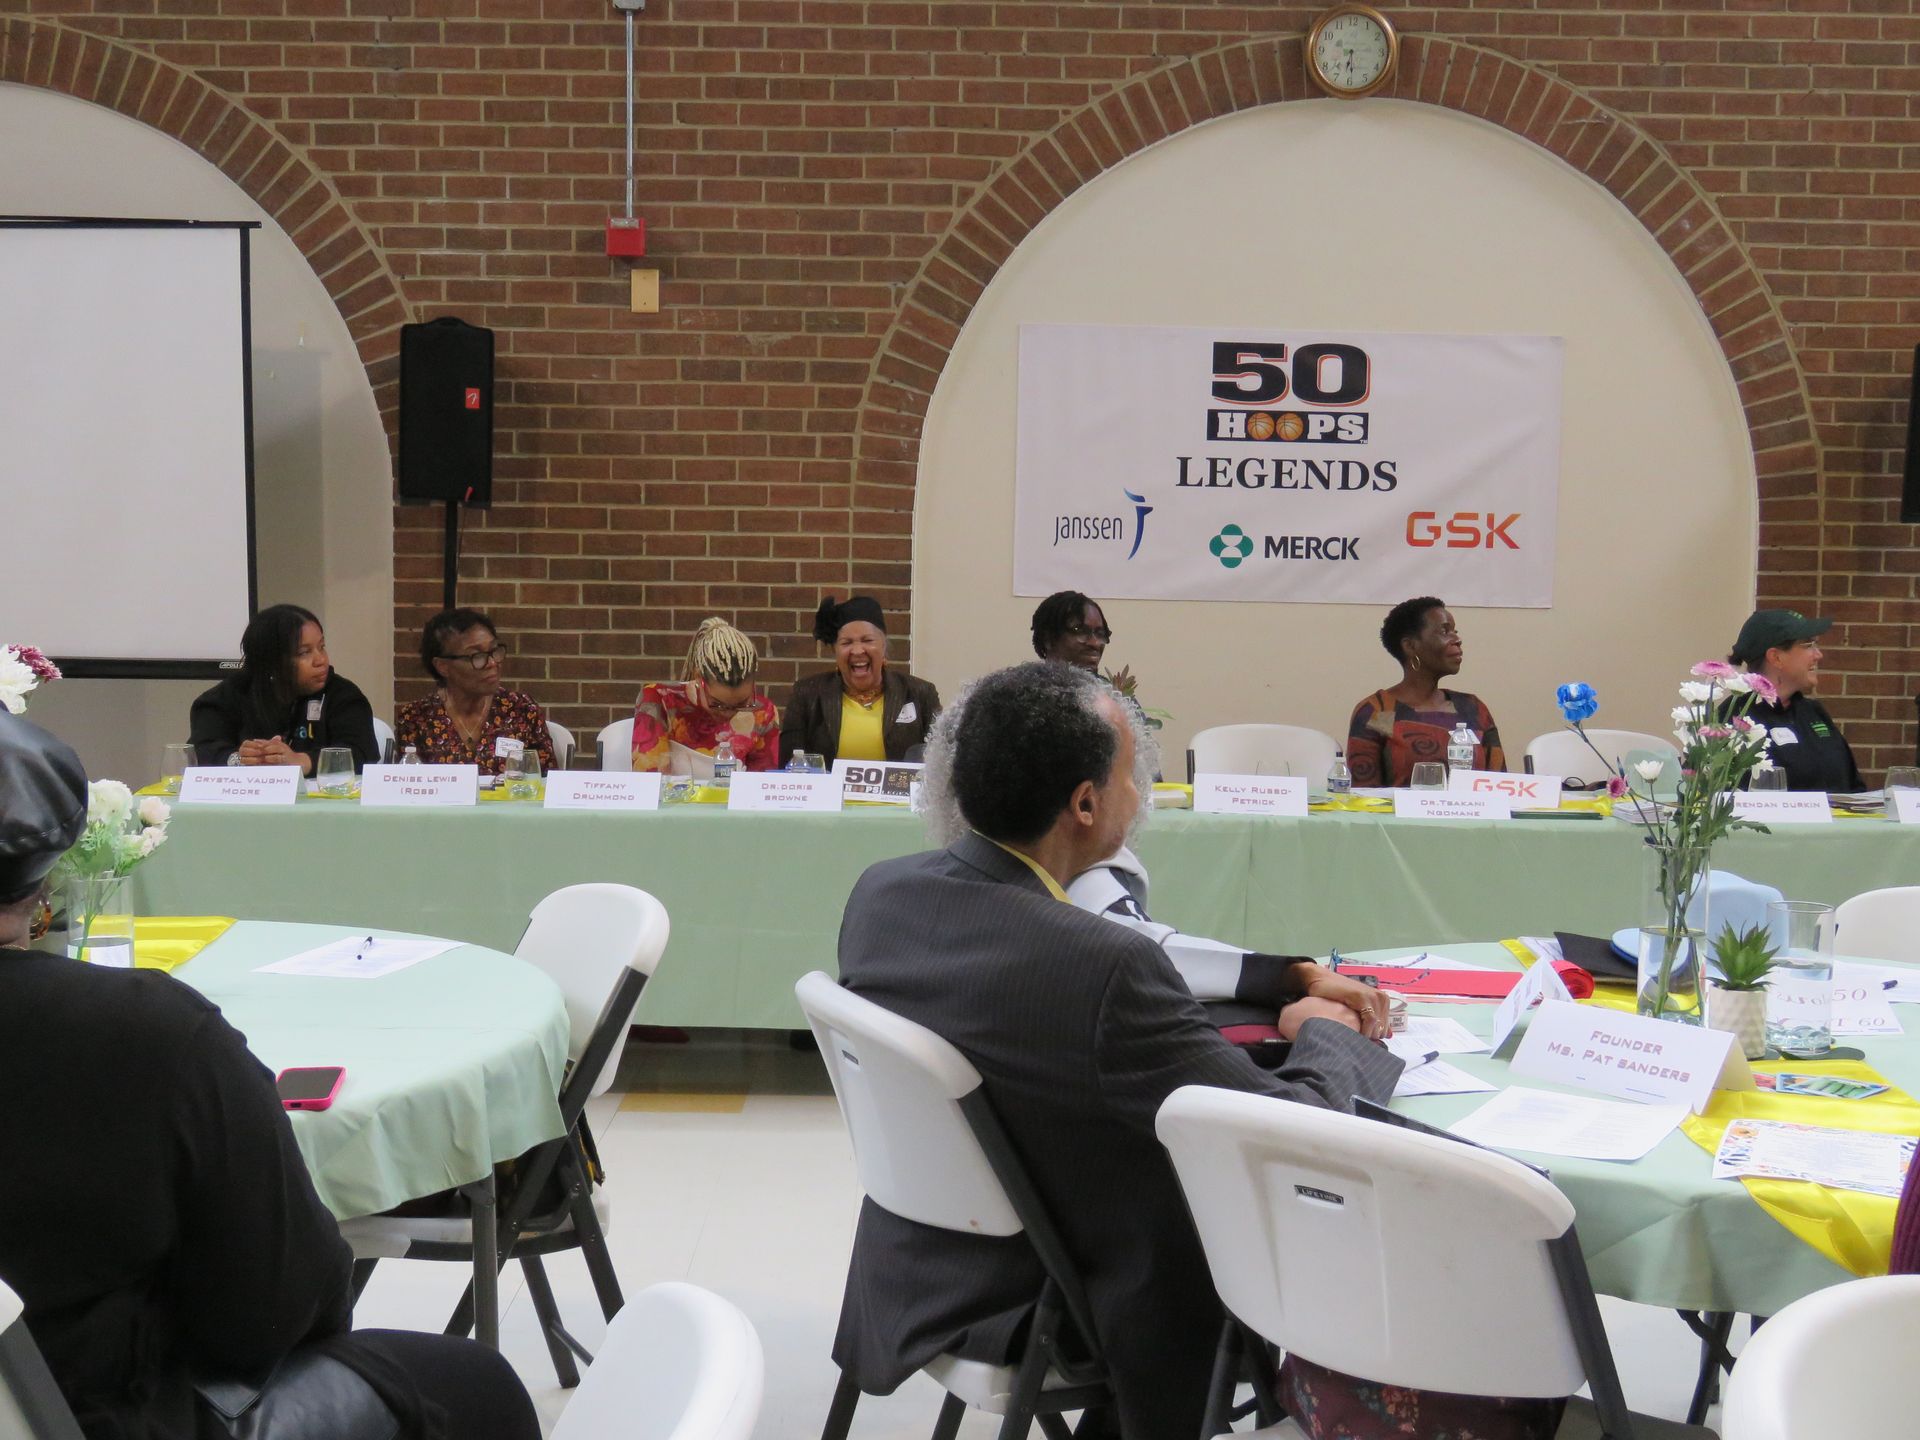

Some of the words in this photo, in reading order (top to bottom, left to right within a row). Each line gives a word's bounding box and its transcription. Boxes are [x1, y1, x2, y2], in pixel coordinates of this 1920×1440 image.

[1335, 20, 1343, 30] 11
[1348, 17, 1358, 26] 12
[1324, 31, 1334, 40] 10
[1374, 32, 1381, 41] 2
[1318, 46, 1325, 56] 9
[1377, 48, 1385, 57] 3
[1322, 62, 1329, 71] 8
[1373, 63, 1379, 71] 4
[1333, 73, 1340, 81] 7
[1346, 77, 1353, 86] 6
[1362, 73, 1368, 83] 5
[1211, 341, 1371, 407] 50
[1216, 411, 1365, 441] HOOPS
[1175, 456, 1398, 492] LEGENDS
[1406, 511, 1522, 549] GSK
[1264, 535, 1360, 560] MERCK
[844, 766, 883, 785] 50
[1472, 778, 1540, 798] GSK
[1590, 1030, 1663, 1055] FOUNDER
[1582, 1049, 1613, 1066] PAT
[1617, 1058, 1691, 1083] SANDERS
